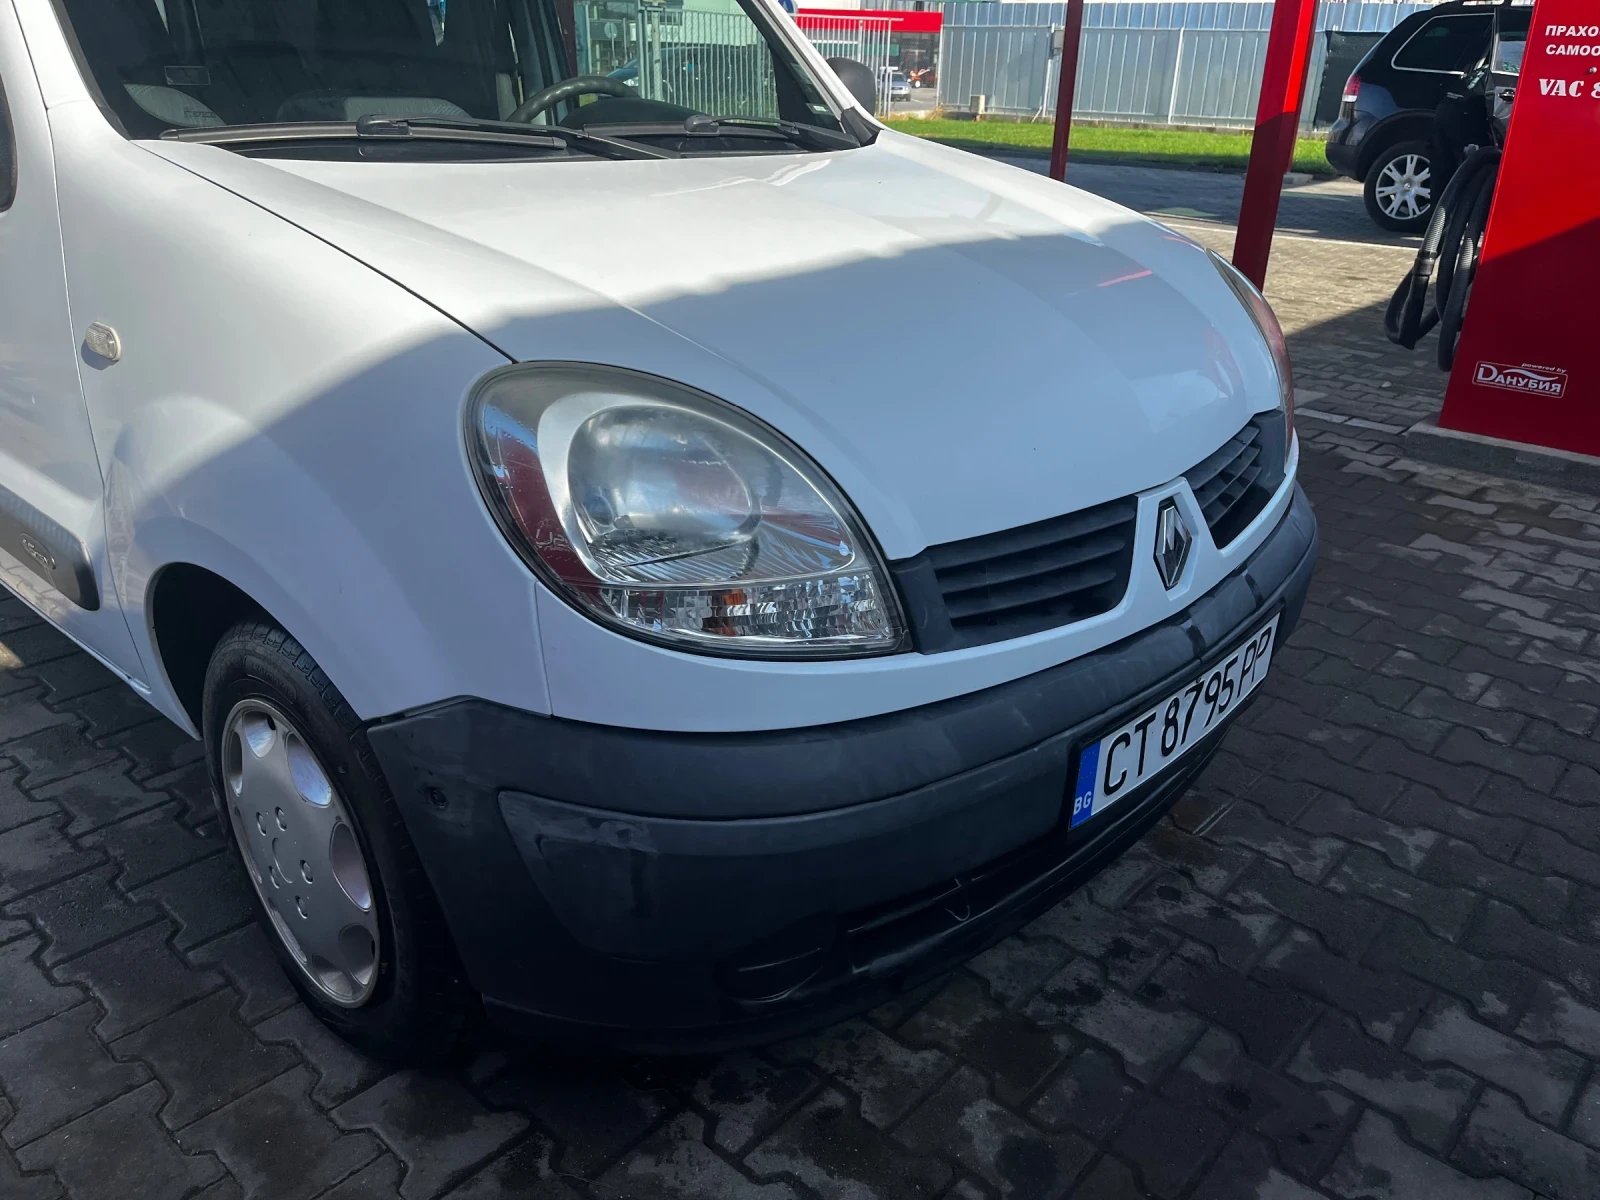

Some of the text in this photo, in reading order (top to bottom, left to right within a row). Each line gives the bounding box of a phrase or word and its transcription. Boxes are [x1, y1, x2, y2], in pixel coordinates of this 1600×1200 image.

[1545, 25, 1600, 37] ПРАХО
[1539, 78, 1584, 97] VAC
[1521, 363, 1555, 372] powered
[1073, 790, 1092, 815] BG
